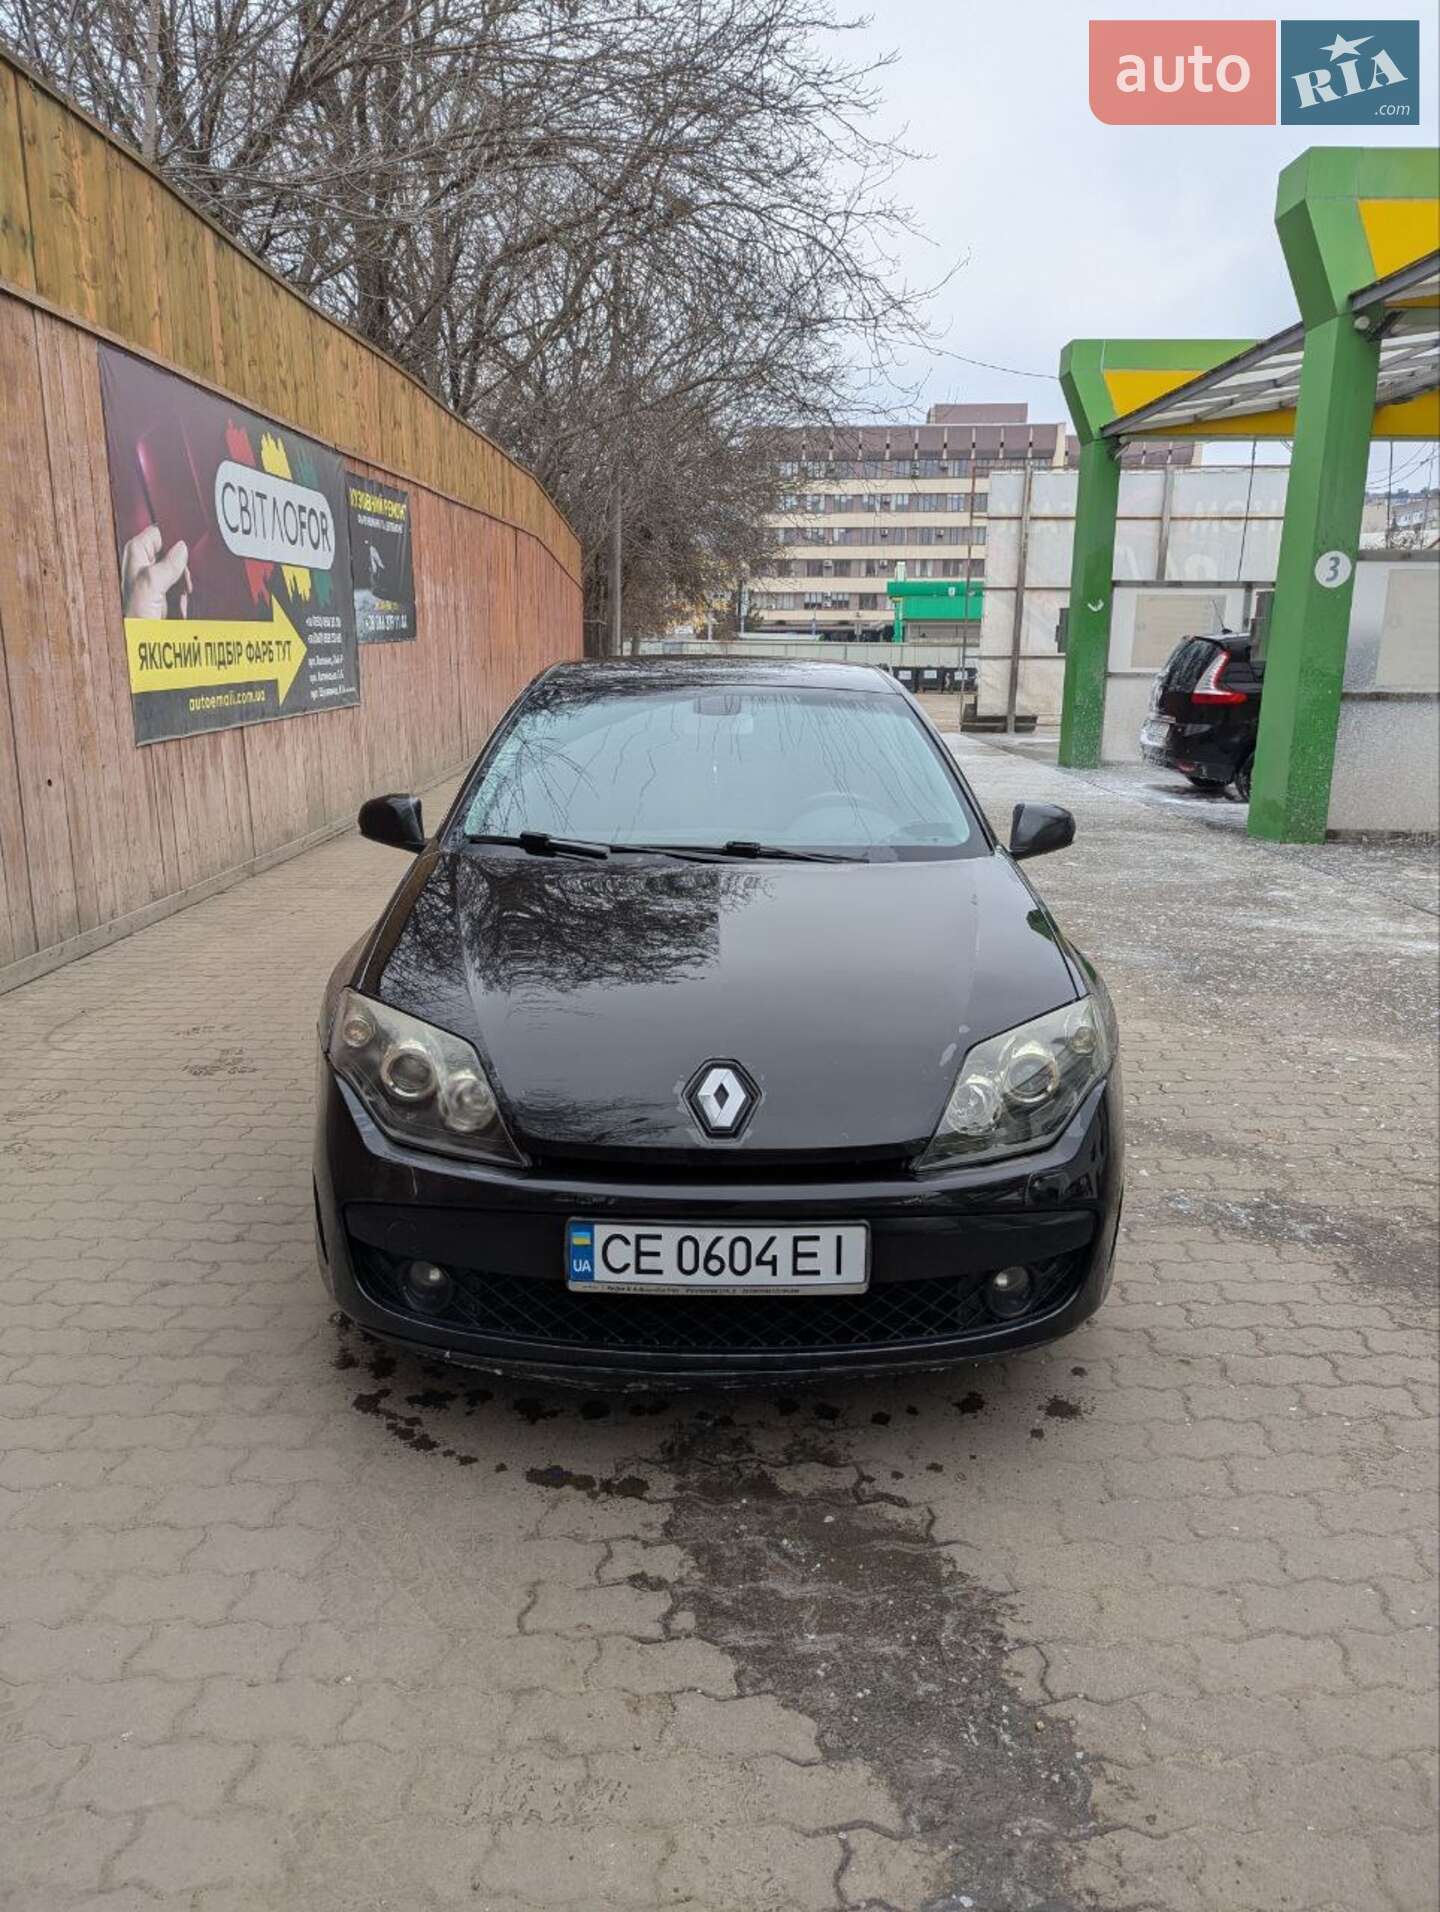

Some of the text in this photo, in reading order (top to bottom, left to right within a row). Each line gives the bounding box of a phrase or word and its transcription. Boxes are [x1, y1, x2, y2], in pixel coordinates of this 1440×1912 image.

[1325, 556, 1340, 582] 3
[138, 636, 202, 671] ЯКІСНИЙ
[204, 641, 243, 671] ПІДБІР
[246, 640, 274, 663] ФАРБ
[275, 640, 292, 662] ТУТ
[573, 1259, 592, 1272] UA
[601, 1233, 843, 1276] CE 0604 EI
